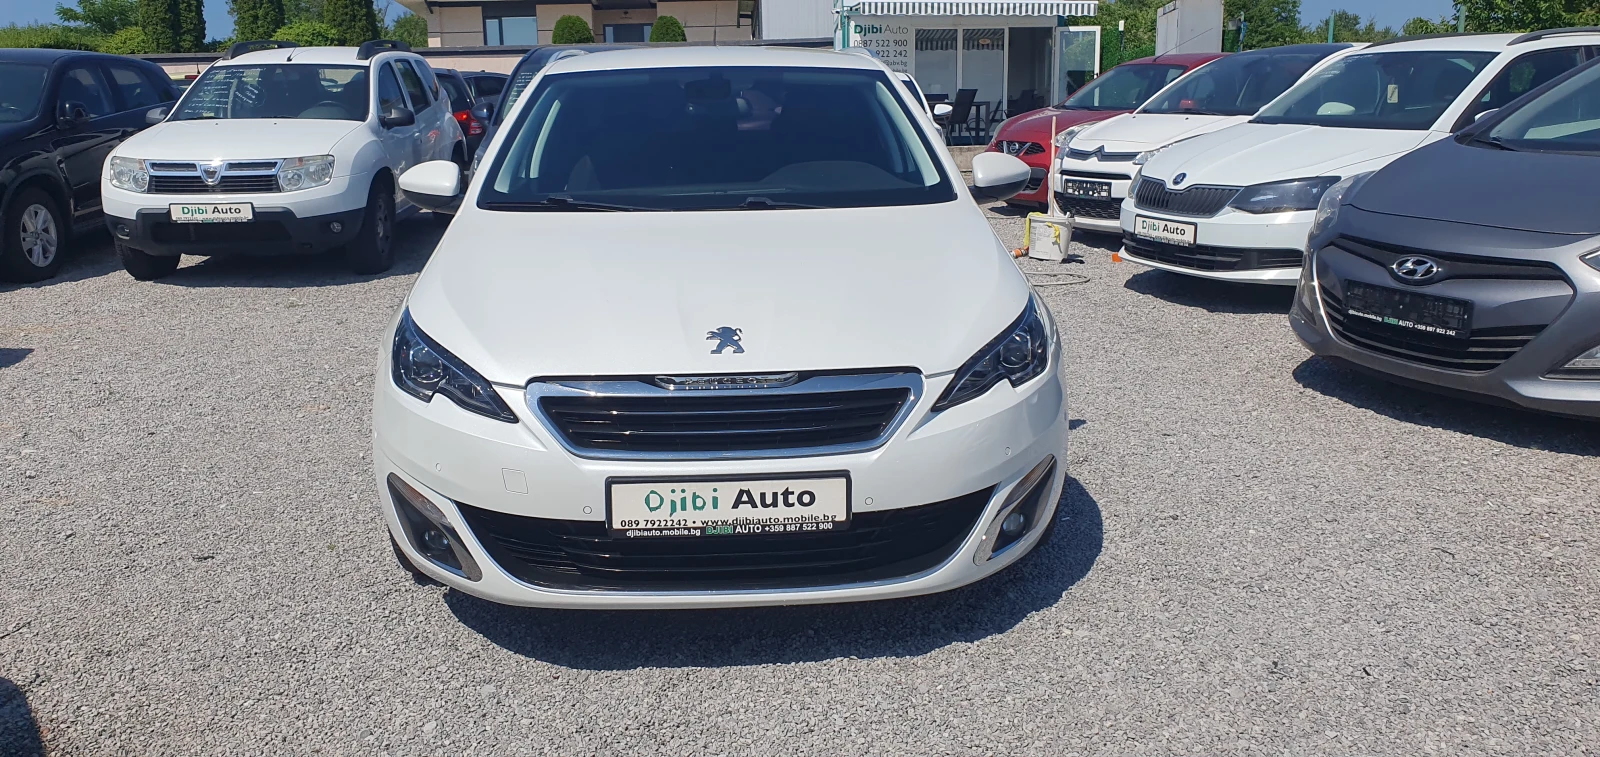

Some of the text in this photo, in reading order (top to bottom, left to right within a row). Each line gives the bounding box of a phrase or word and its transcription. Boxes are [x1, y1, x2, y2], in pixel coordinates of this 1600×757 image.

[854, 24, 909, 37] Djibi Auto
[854, 39, 908, 48] 0887 522 900
[875, 50, 908, 58] 922 242
[181, 205, 242, 217] Djibi Auto
[1142, 220, 1186, 235] Djibi Auto
[1398, 319, 1414, 328] AUTO
[644, 486, 816, 517] Djibi Auto
[620, 519, 640, 528] 089
[643, 518, 688, 528] 7922242
[626, 522, 834, 538] djibiauto.mobile.bg DJIBI AUTO +359 887 522 900
